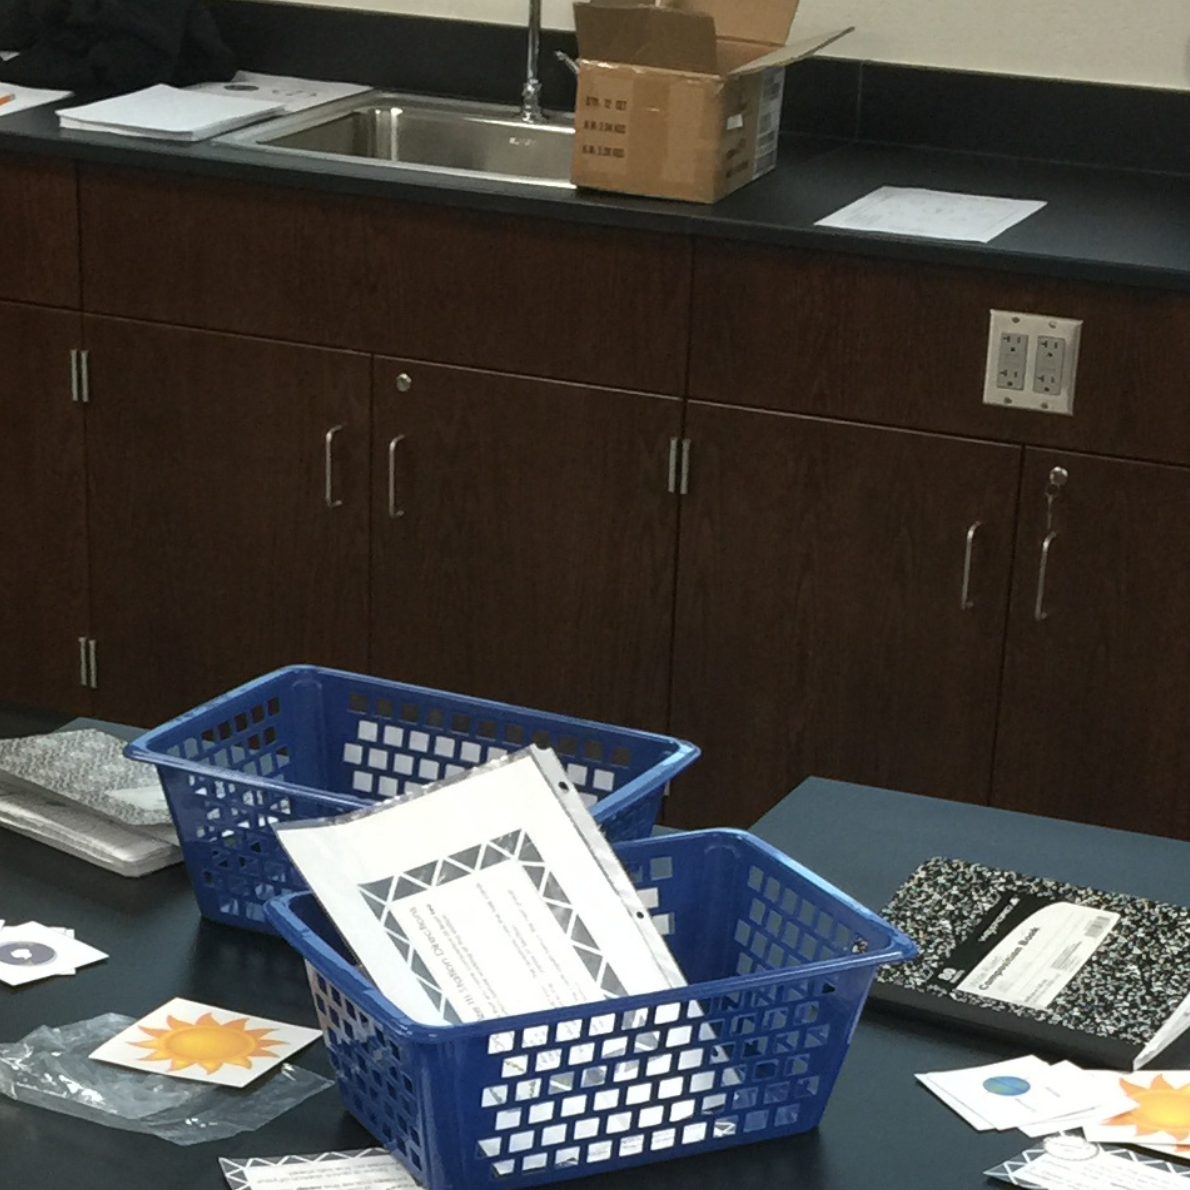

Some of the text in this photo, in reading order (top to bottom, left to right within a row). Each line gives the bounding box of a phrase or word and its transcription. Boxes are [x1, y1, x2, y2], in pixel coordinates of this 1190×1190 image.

[410, 907, 444, 956] Directions
[442, 958, 466, 992] Station
[978, 926, 1040, 991] Composition Book
